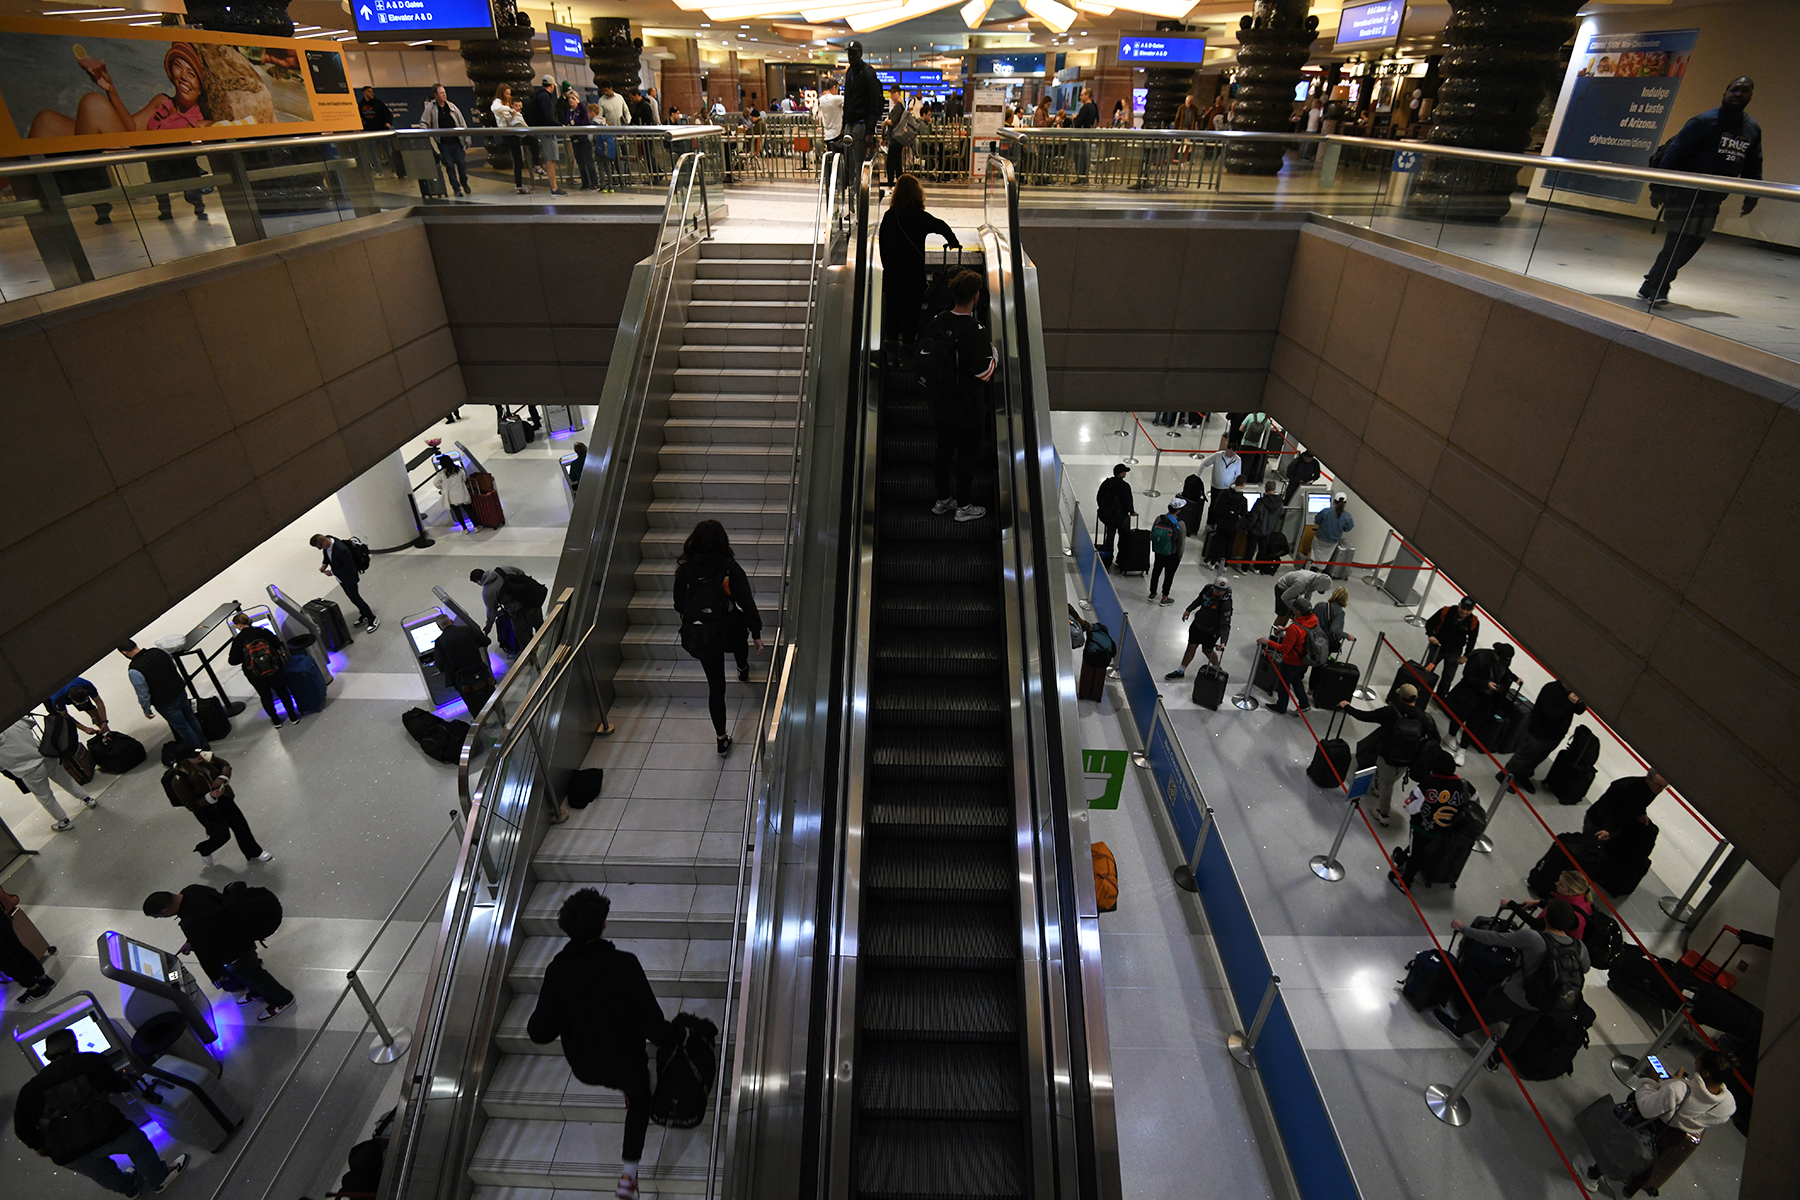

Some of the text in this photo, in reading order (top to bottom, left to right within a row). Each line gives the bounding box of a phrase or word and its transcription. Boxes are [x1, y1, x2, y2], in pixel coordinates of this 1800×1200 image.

[386, 1, 392, 9] A
[405, 0, 424, 8] Gates
[1641, 86, 1670, 99] Indulge
[1629, 102, 1664, 113] in a taste
[1620, 117, 1657, 129] of Arizona.
[1589, 134, 1652, 150] skyharbor.com/dining
[1721, 136, 1750, 152] TRUE
